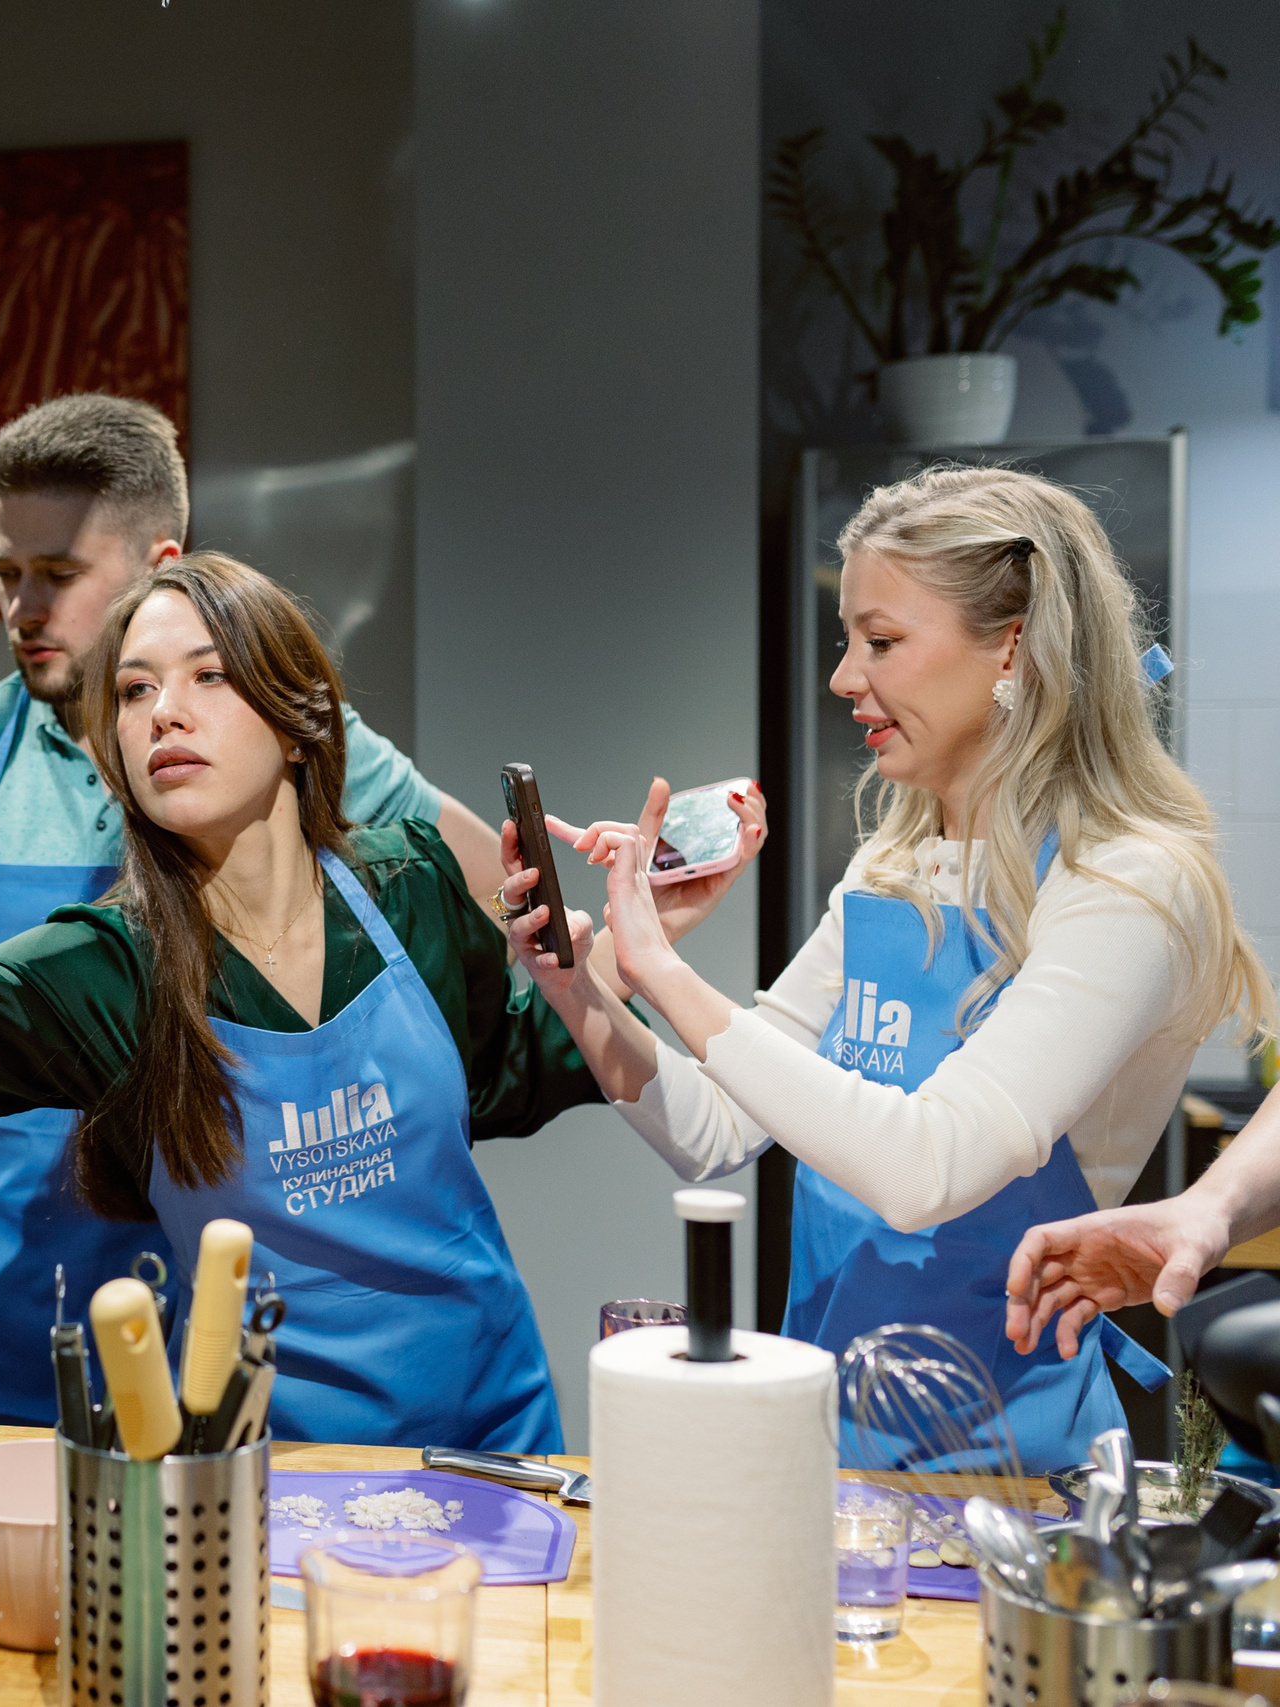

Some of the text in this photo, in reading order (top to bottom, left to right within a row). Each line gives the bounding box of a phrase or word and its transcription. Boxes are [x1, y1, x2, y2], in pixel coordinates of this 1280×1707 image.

[844, 978, 912, 1048] lia
[841, 1042, 905, 1076] SKAYA
[269, 1082, 394, 1153] Julia
[270, 1122, 397, 1174] VYSOTSKAYA
[282, 1147, 392, 1192] КУЛИНАРНАЯ
[286, 1161, 396, 1216] СТУДИЯ
